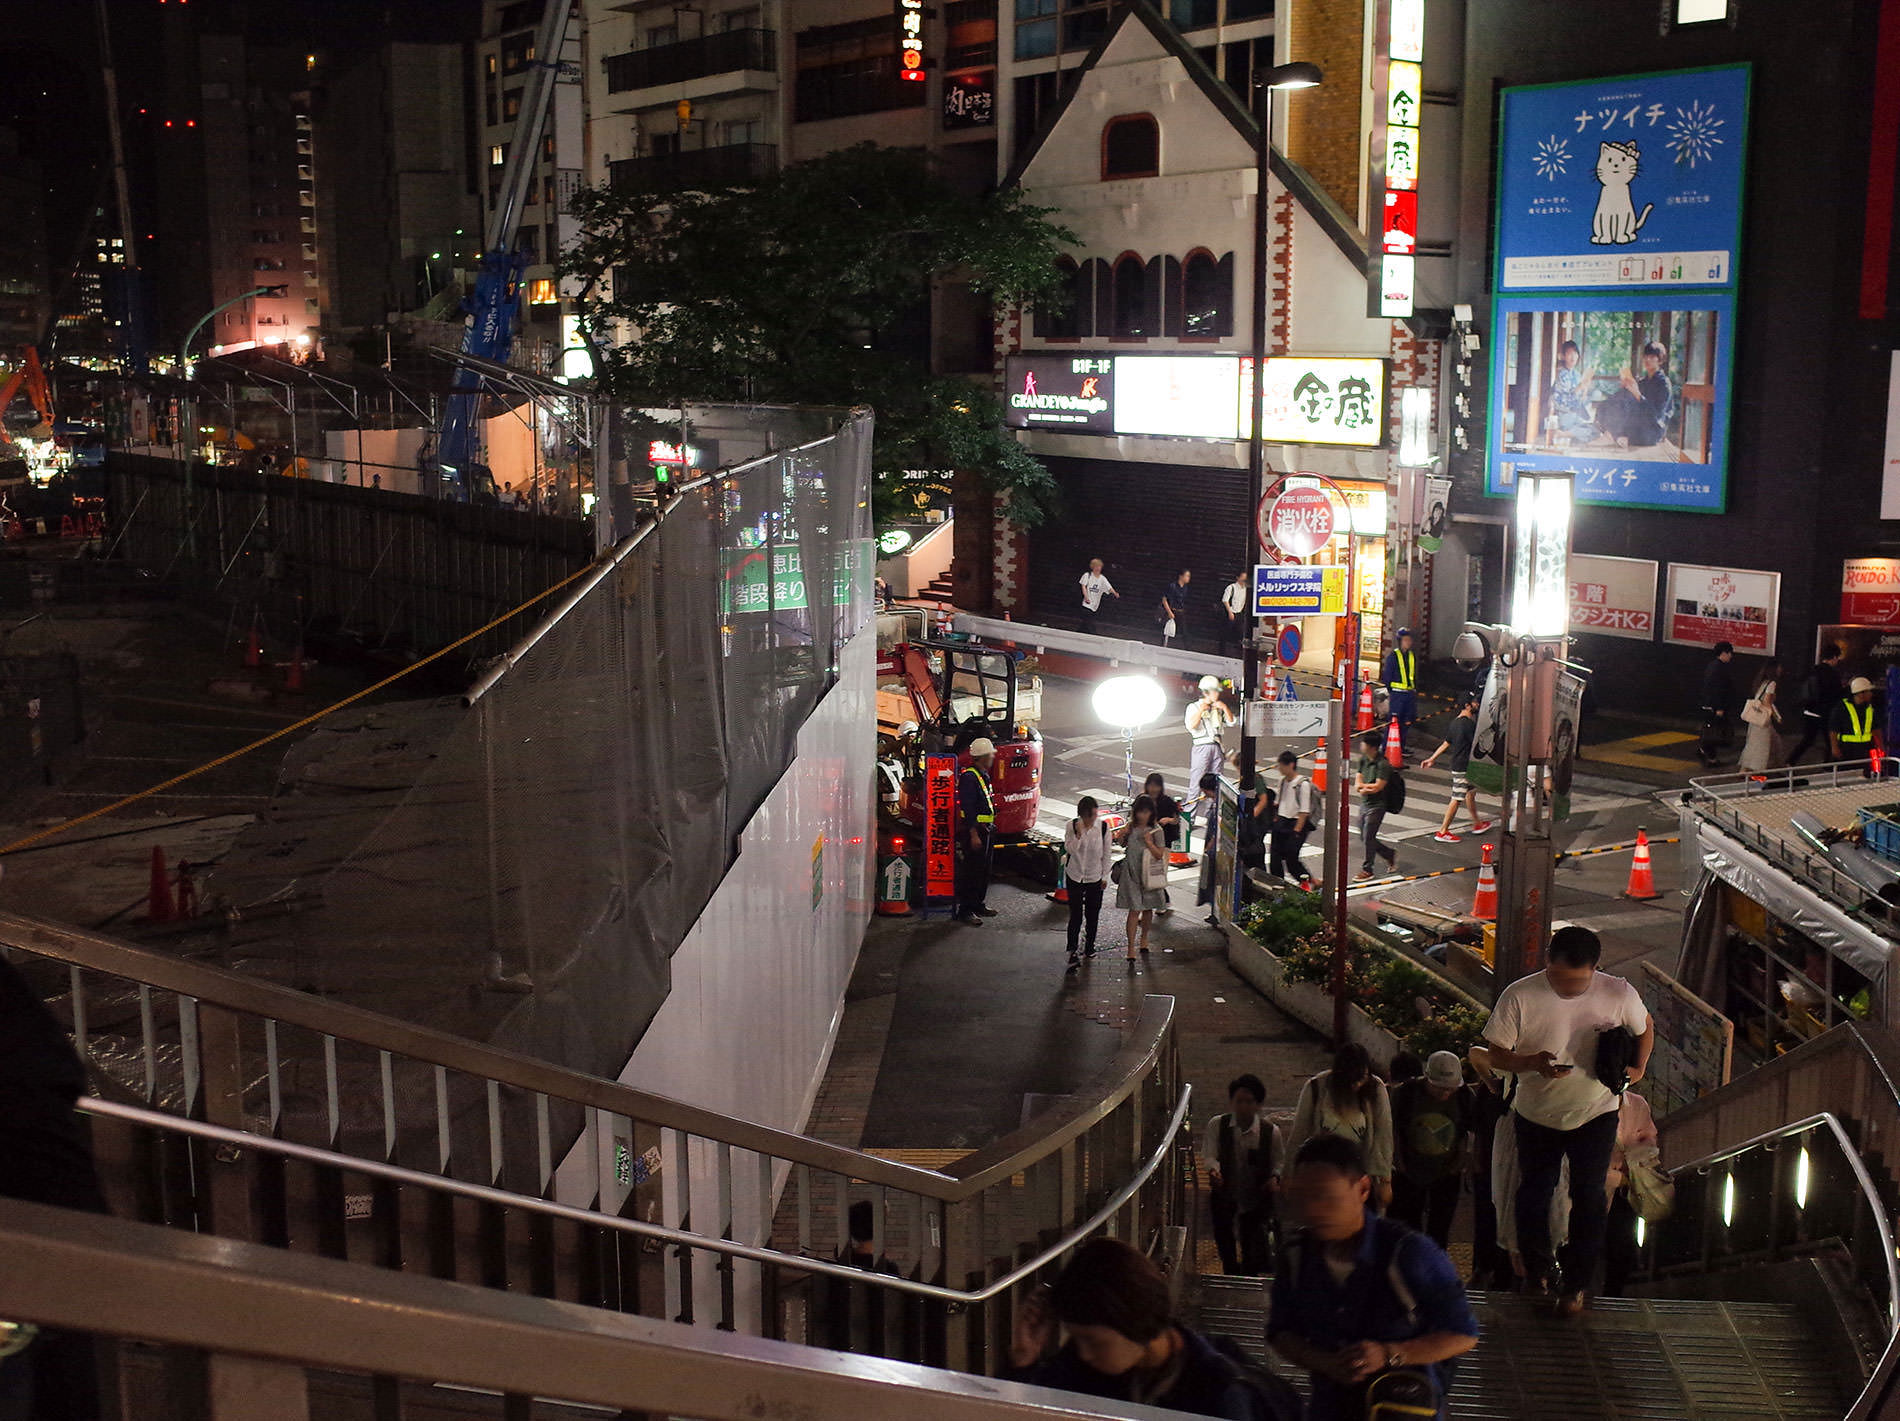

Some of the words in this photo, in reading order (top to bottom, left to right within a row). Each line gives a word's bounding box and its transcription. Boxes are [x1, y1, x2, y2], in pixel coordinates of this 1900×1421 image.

[1574, 103, 1666, 133] ナツイチ
[1072, 359, 1111, 374] B1F-1F
[1281, 495, 1296, 504] FIRE
[1296, 495, 1325, 504] HYDRANT
[1276, 507, 1331, 535] 消火栓
[1257, 582, 1322, 593] メルリックス学院
[931, 776, 951, 856] 歩行者通路
